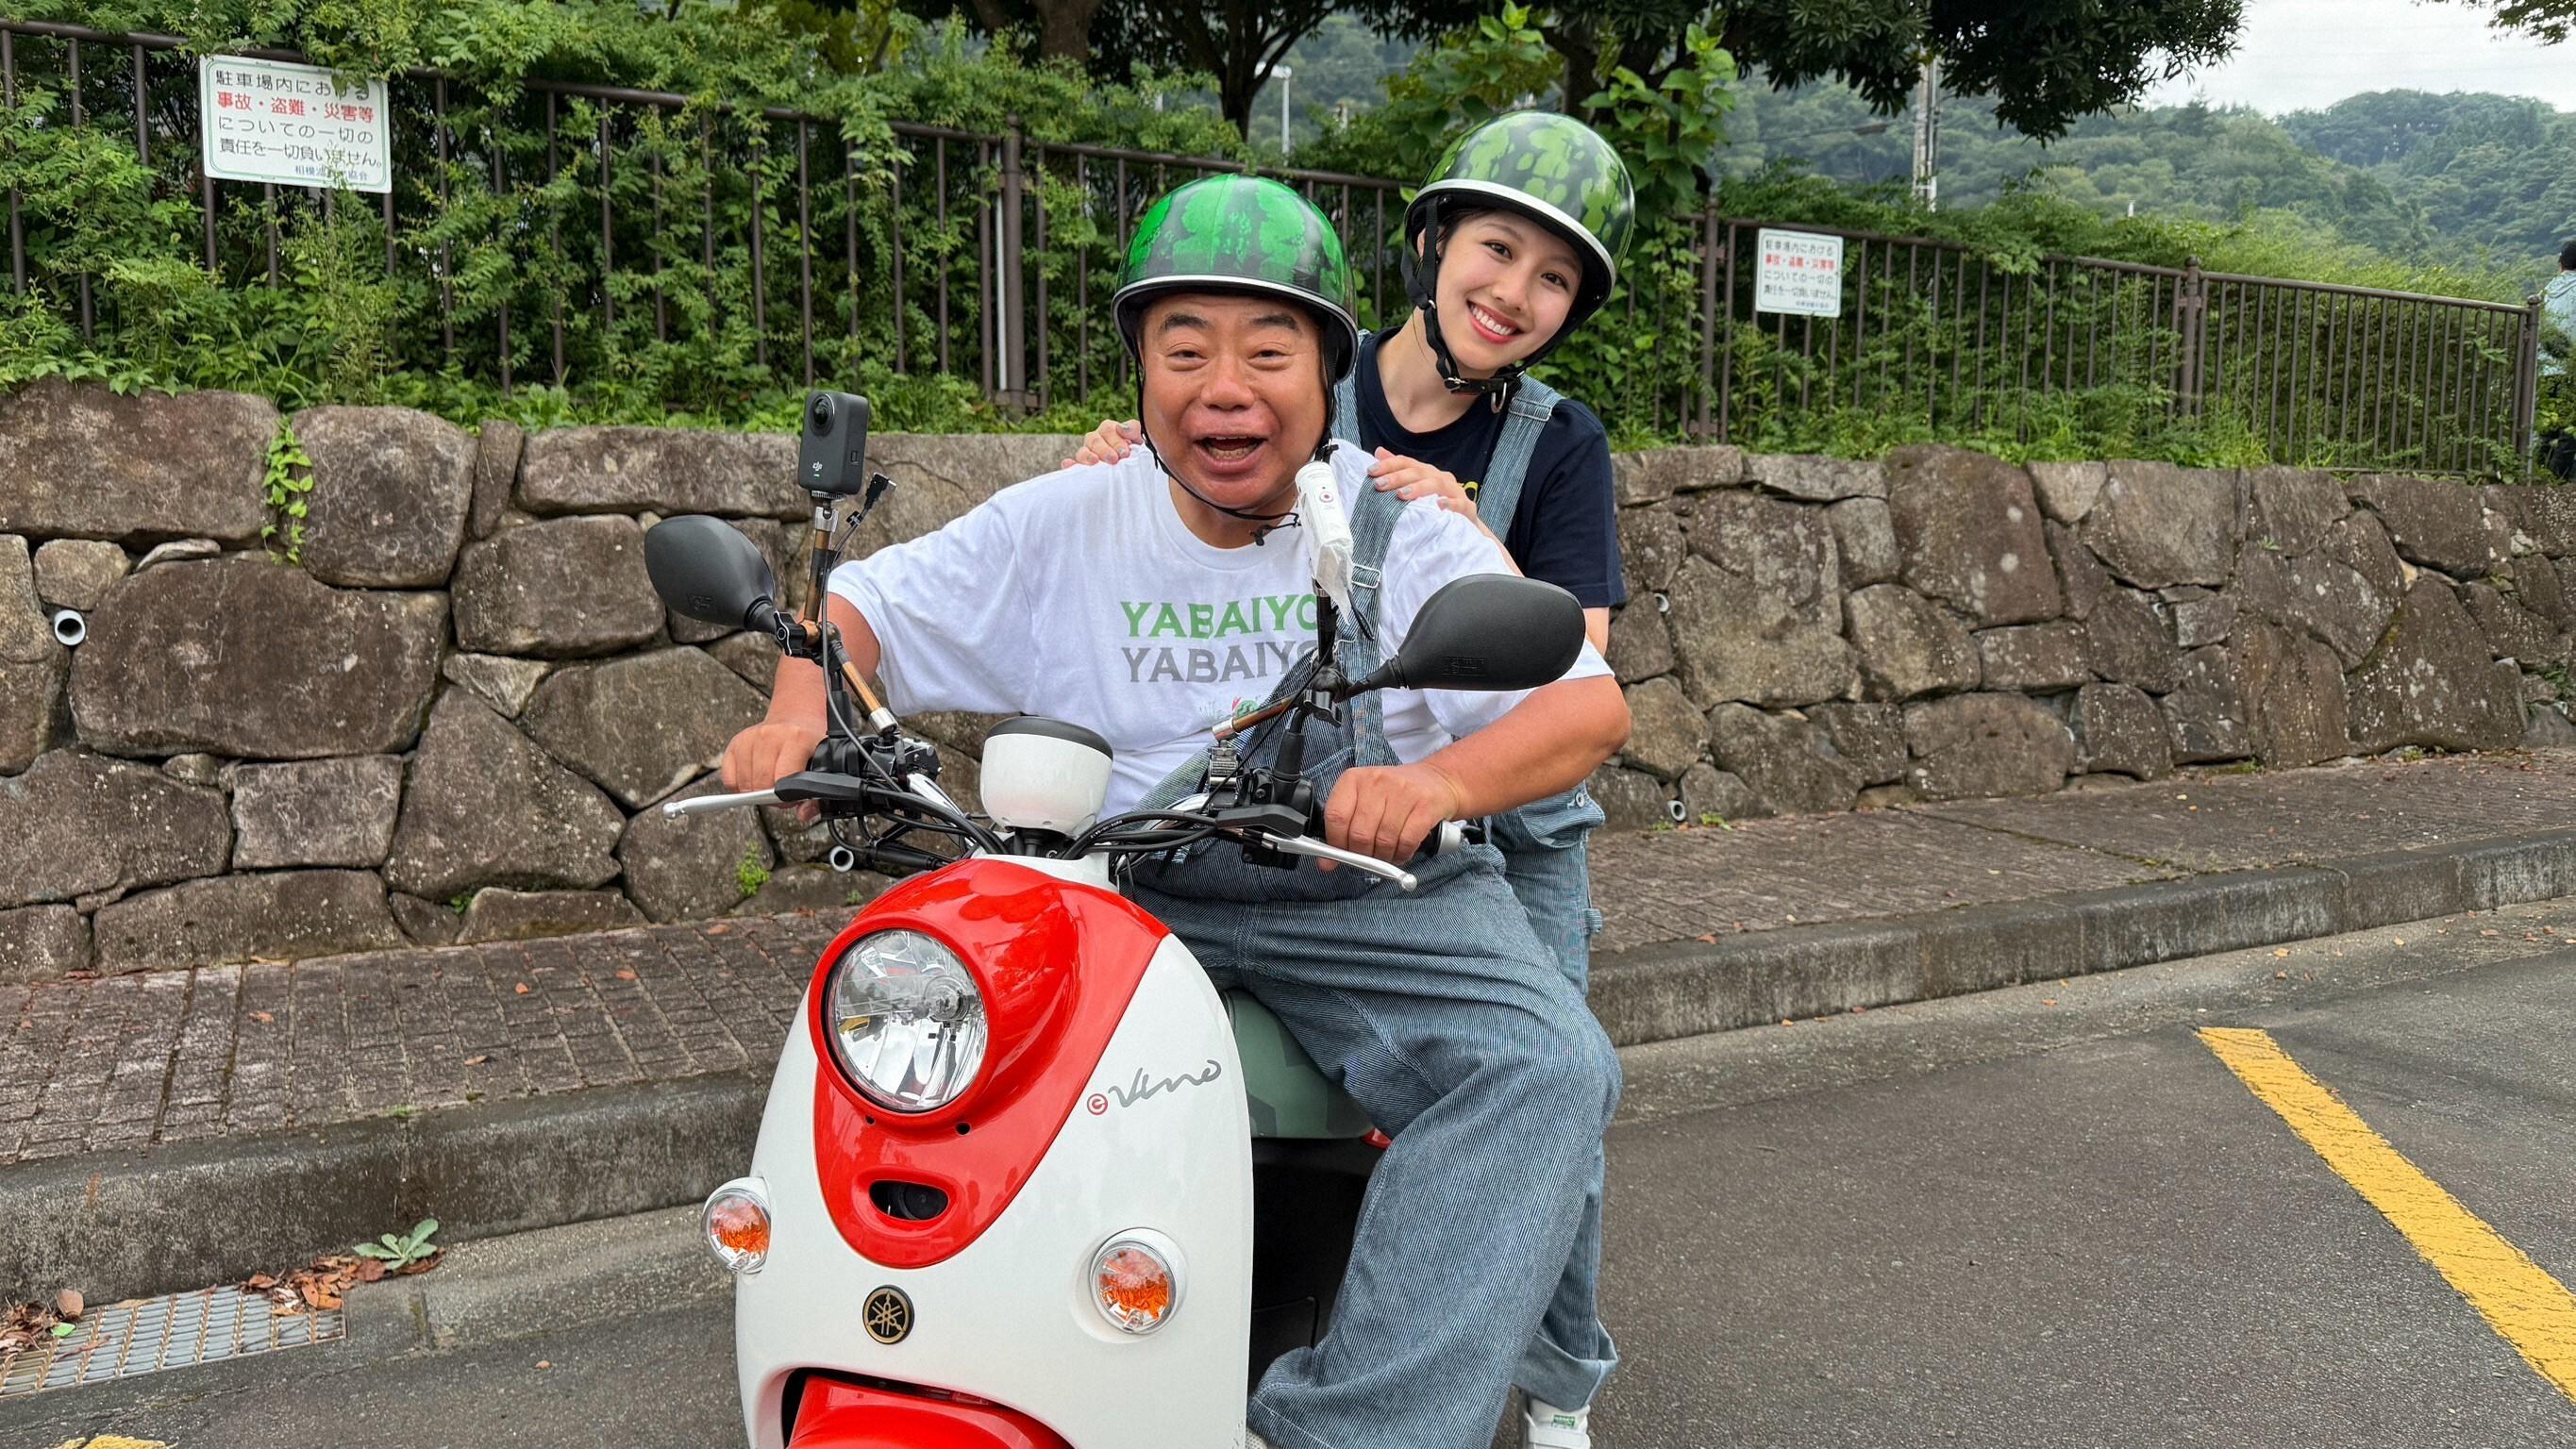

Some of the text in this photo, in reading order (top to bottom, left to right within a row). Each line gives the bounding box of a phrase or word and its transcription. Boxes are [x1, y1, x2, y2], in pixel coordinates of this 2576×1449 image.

[217, 91, 374, 124] 事故・盗難・災害等
[219, 115, 373, 144] についての一切の
